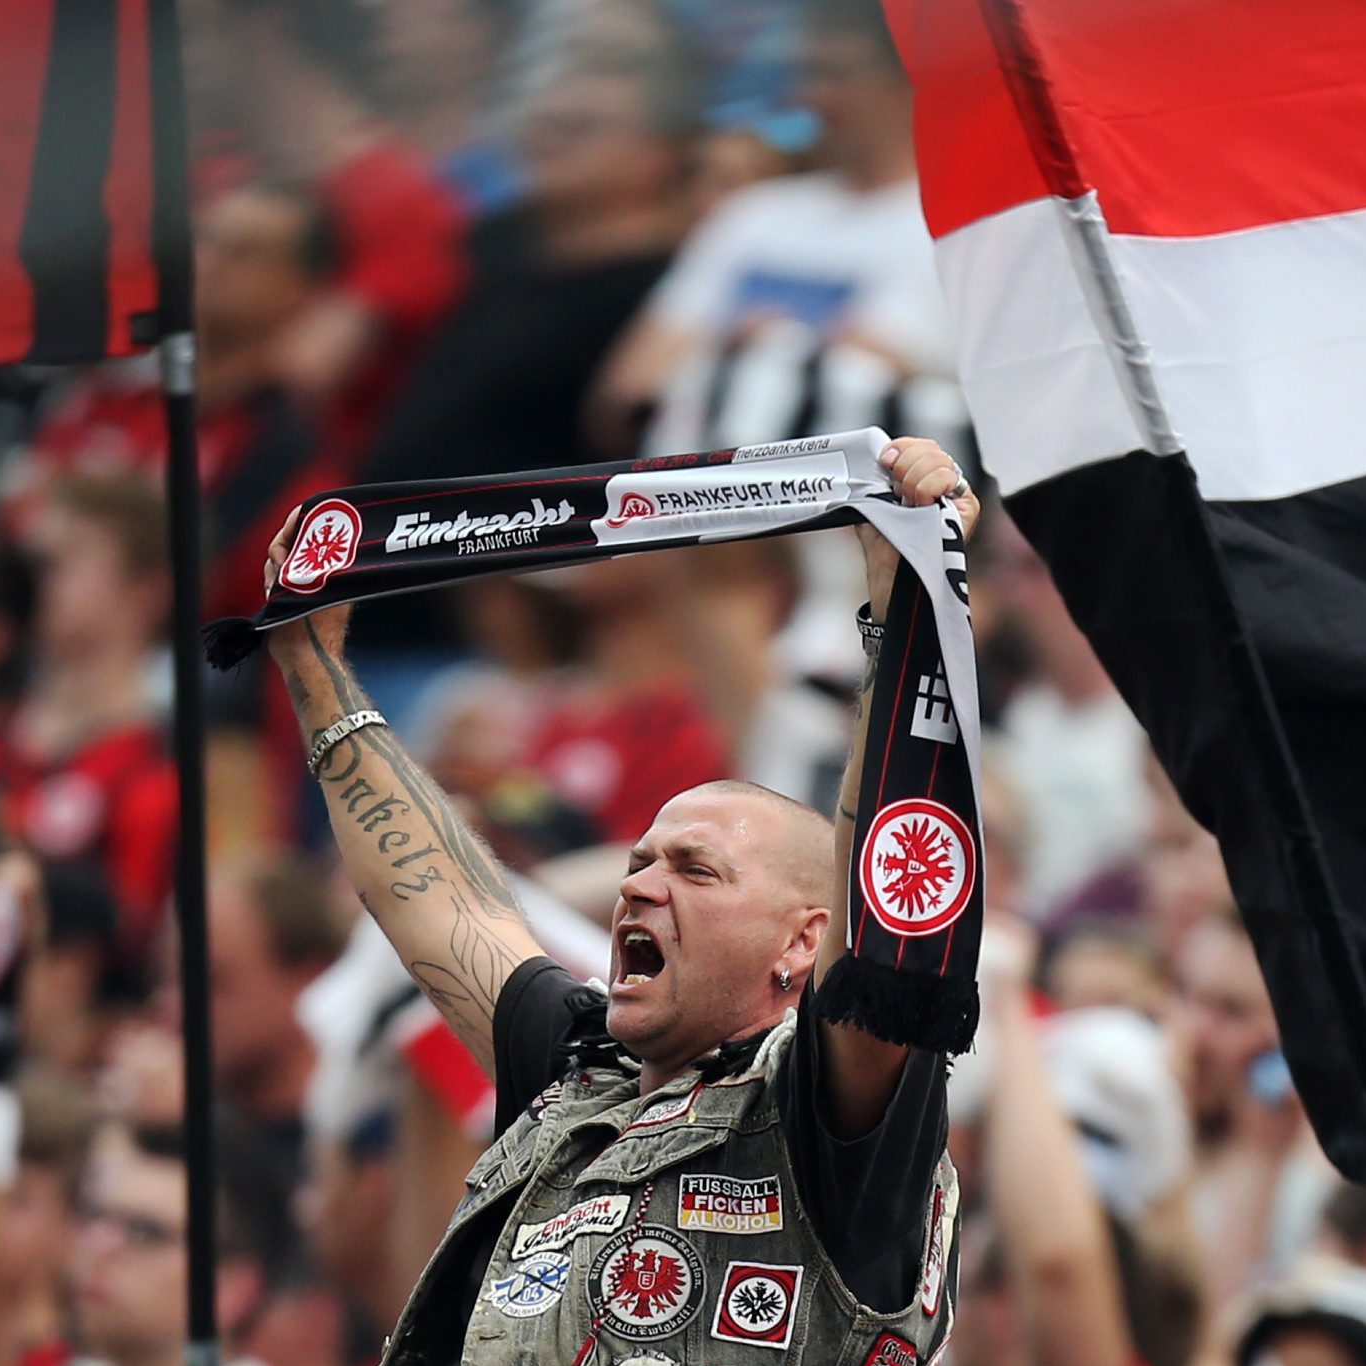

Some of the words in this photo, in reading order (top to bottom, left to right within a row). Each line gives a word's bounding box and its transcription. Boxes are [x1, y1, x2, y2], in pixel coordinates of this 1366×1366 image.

[655, 481, 772, 510] FRANKFURT
[385, 498, 575, 553] Eintracht
[457, 527, 541, 556] FRANKFURT
[688, 1178, 774, 1199] FUSSBALL
[694, 1195, 767, 1214] FICKEN
[686, 1210, 773, 1230] ALKOHOL
